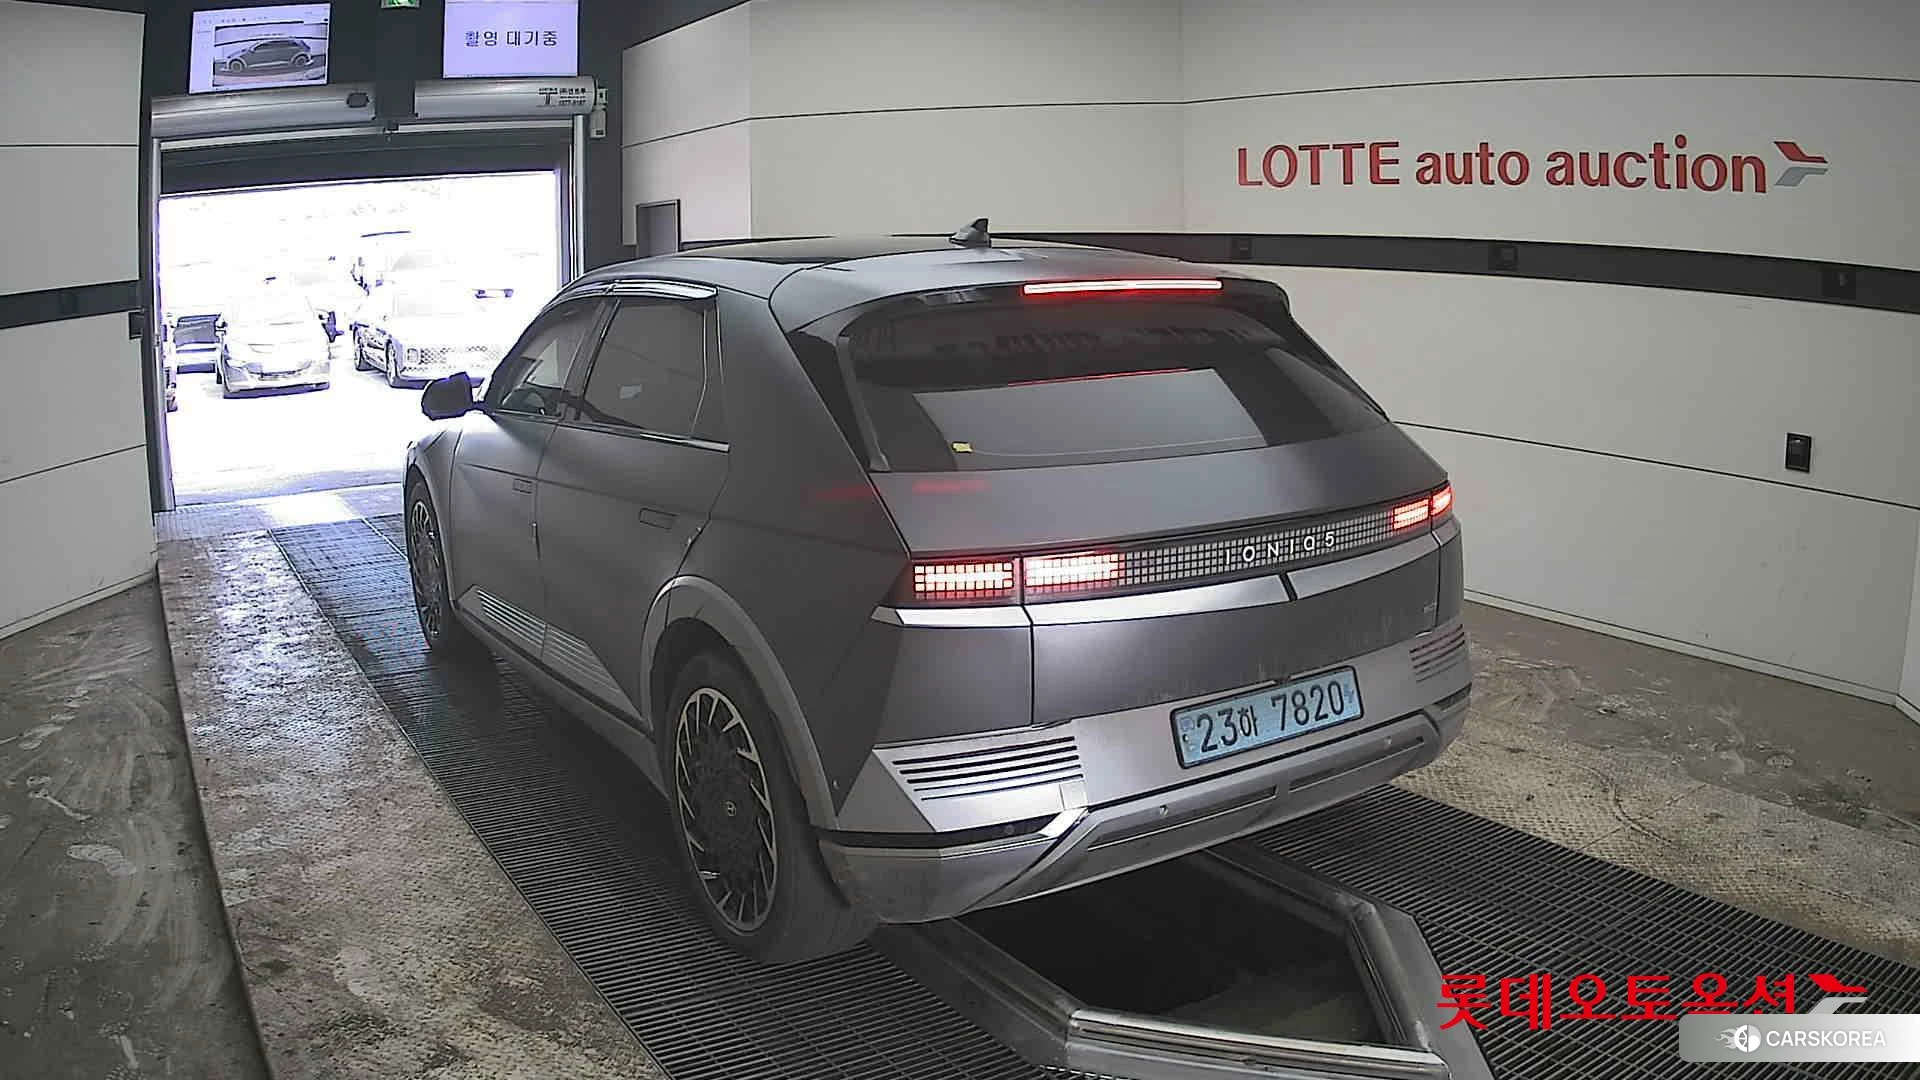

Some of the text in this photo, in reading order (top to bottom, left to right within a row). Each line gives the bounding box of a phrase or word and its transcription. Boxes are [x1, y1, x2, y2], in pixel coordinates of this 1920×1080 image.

[506, 30, 558, 46] 대기중
[1238, 133, 1767, 195] LOTTE auto auction
[1226, 531, 1336, 565] IONIQ 5
[1197, 680, 1345, 753] 23하 7820
